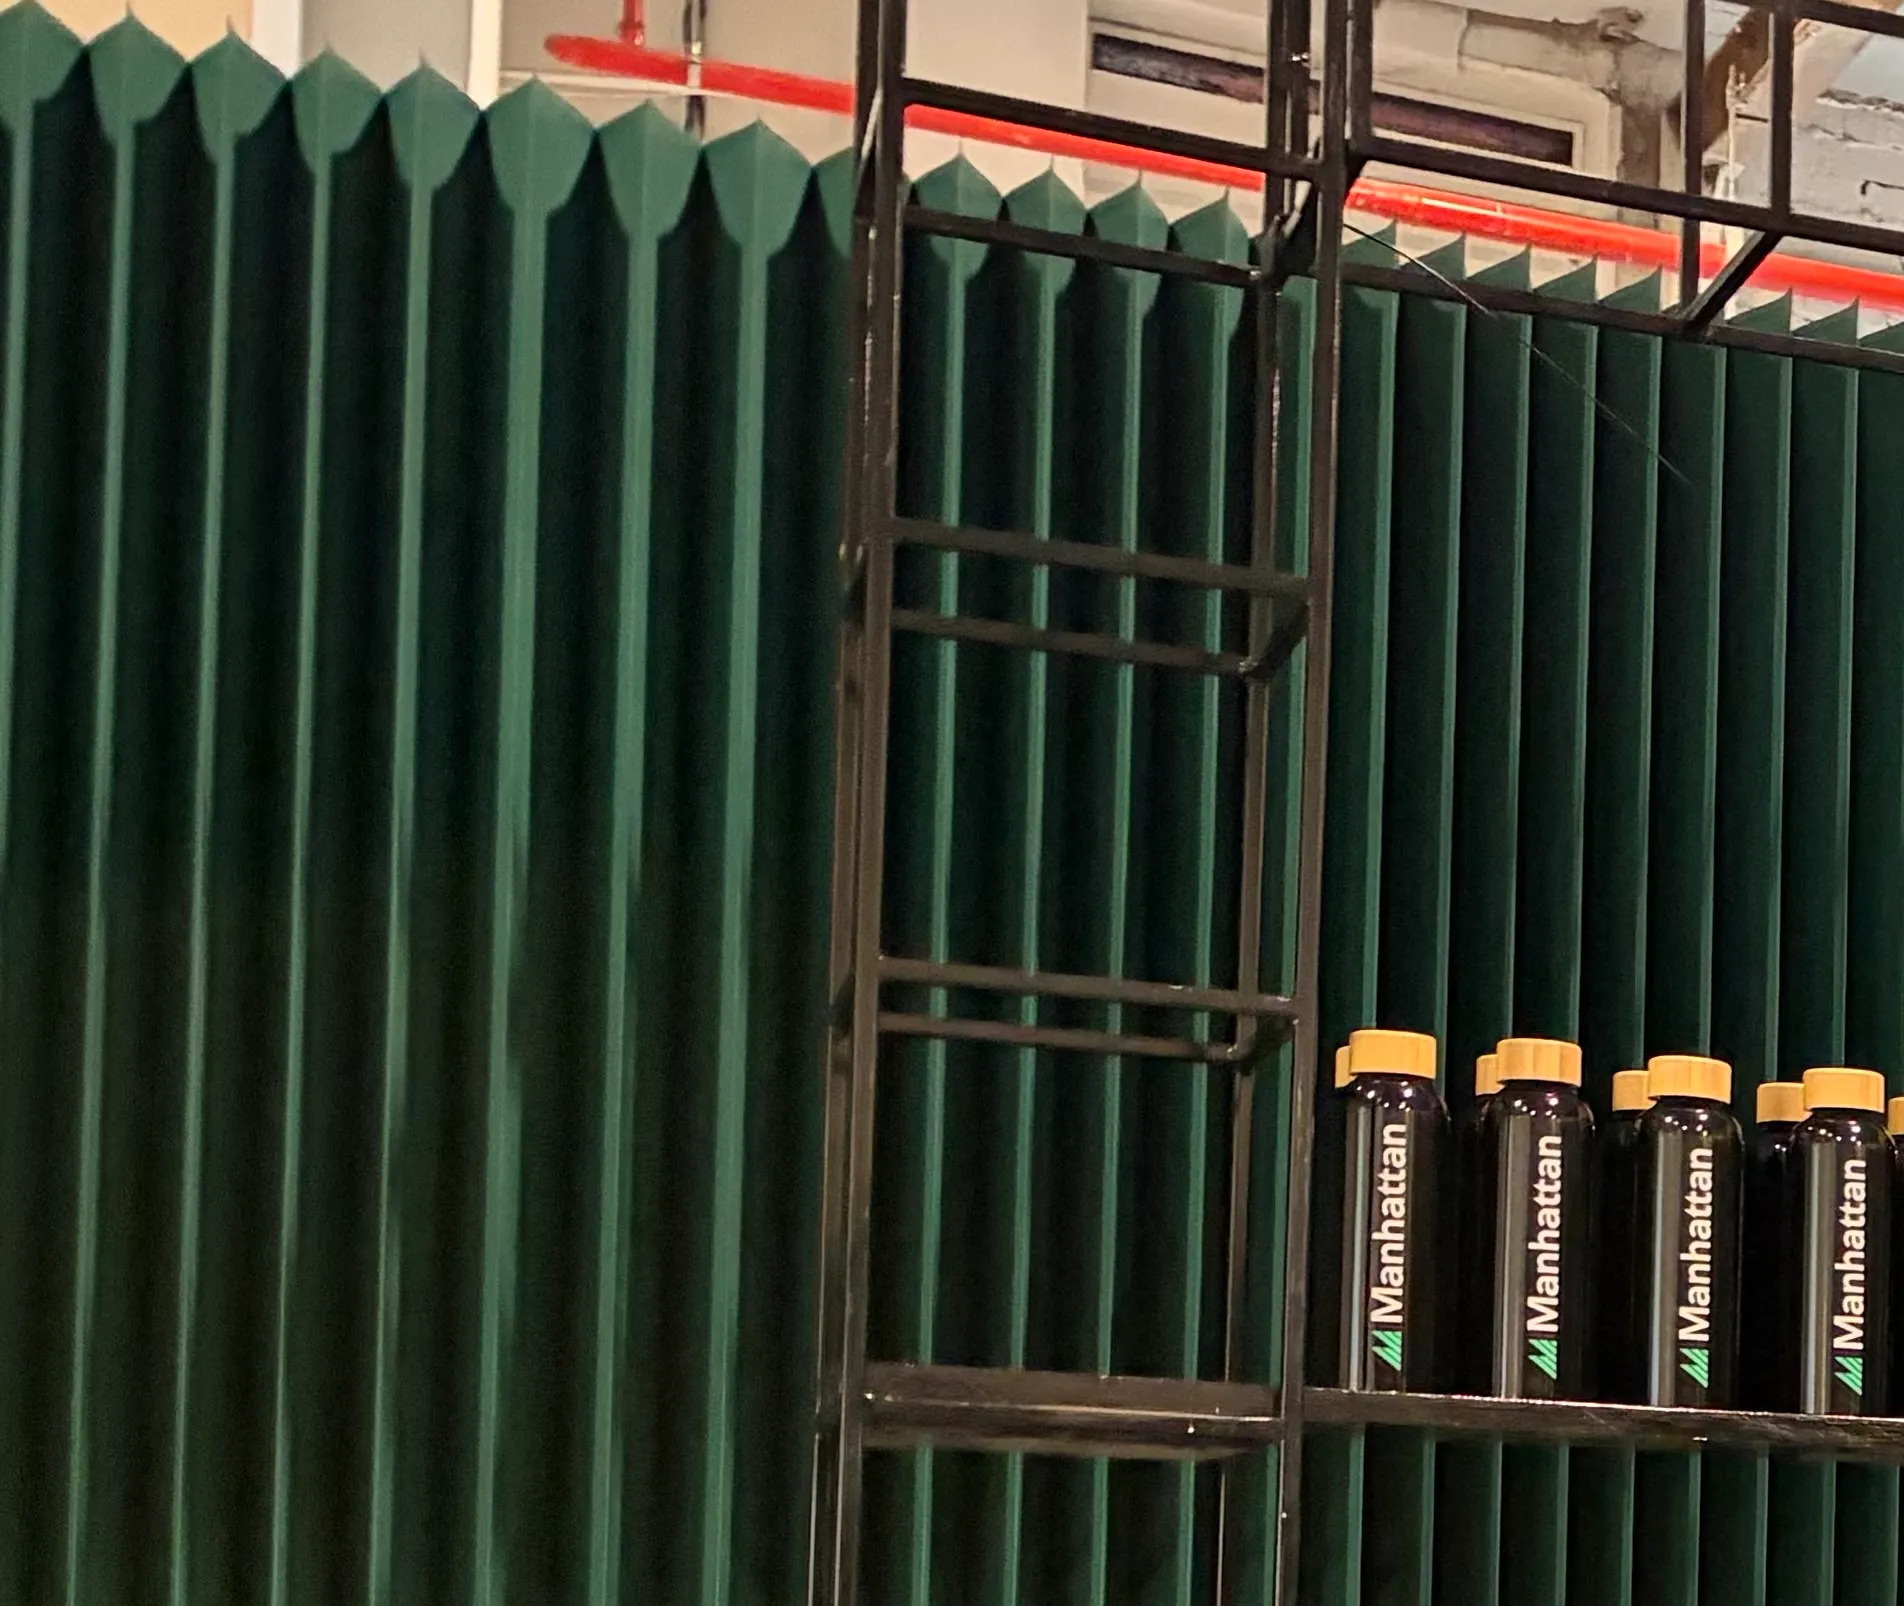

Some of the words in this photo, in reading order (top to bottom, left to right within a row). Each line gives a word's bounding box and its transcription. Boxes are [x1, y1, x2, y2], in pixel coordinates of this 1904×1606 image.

[1370, 1123, 1408, 1324] Manhattan
[1526, 1135, 1562, 1333] Manhattan
[1678, 1147, 1714, 1342] Manhattan
[1832, 1158, 1867, 1351] Manhattan
